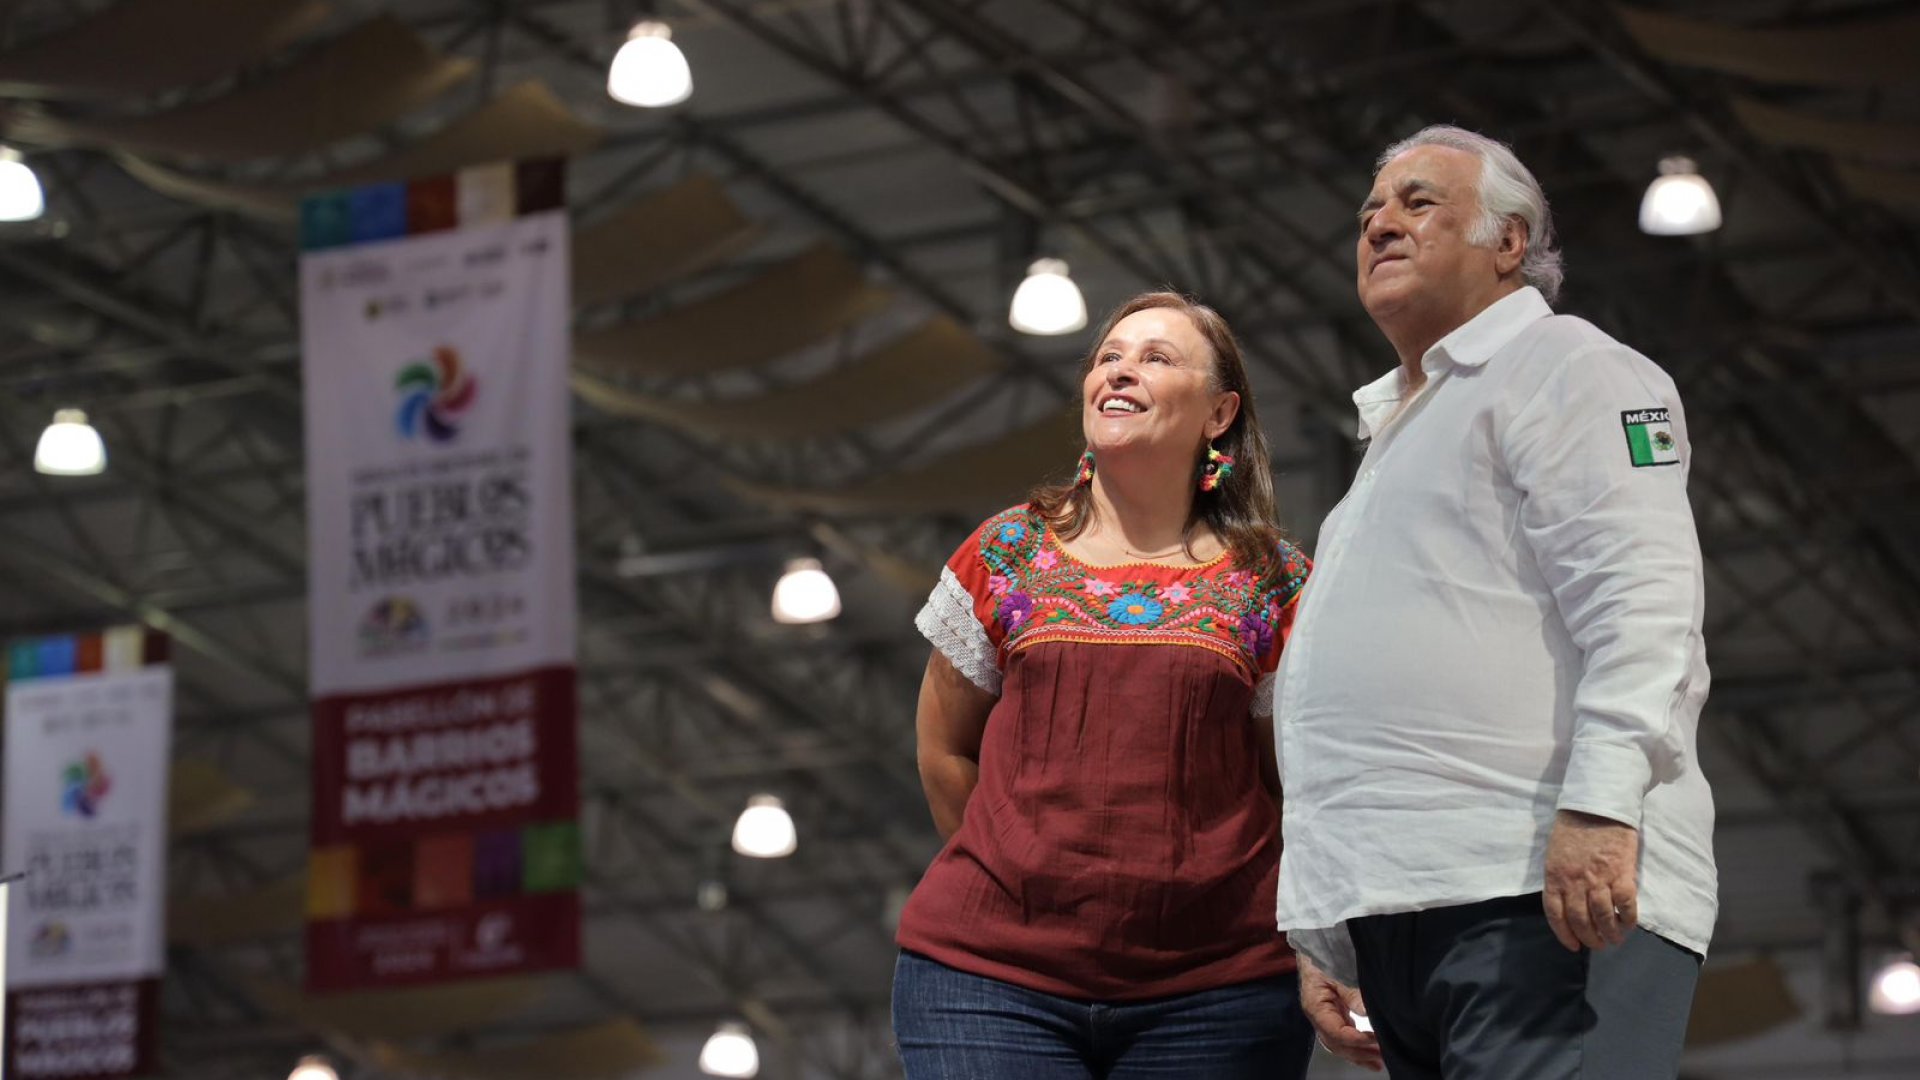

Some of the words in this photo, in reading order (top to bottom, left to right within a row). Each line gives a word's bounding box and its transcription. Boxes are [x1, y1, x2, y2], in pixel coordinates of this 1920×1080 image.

[1625, 410, 1670, 424] MÉXIC
[347, 720, 536, 780] BARRIOS
[343, 763, 539, 824] MÁGICOS
